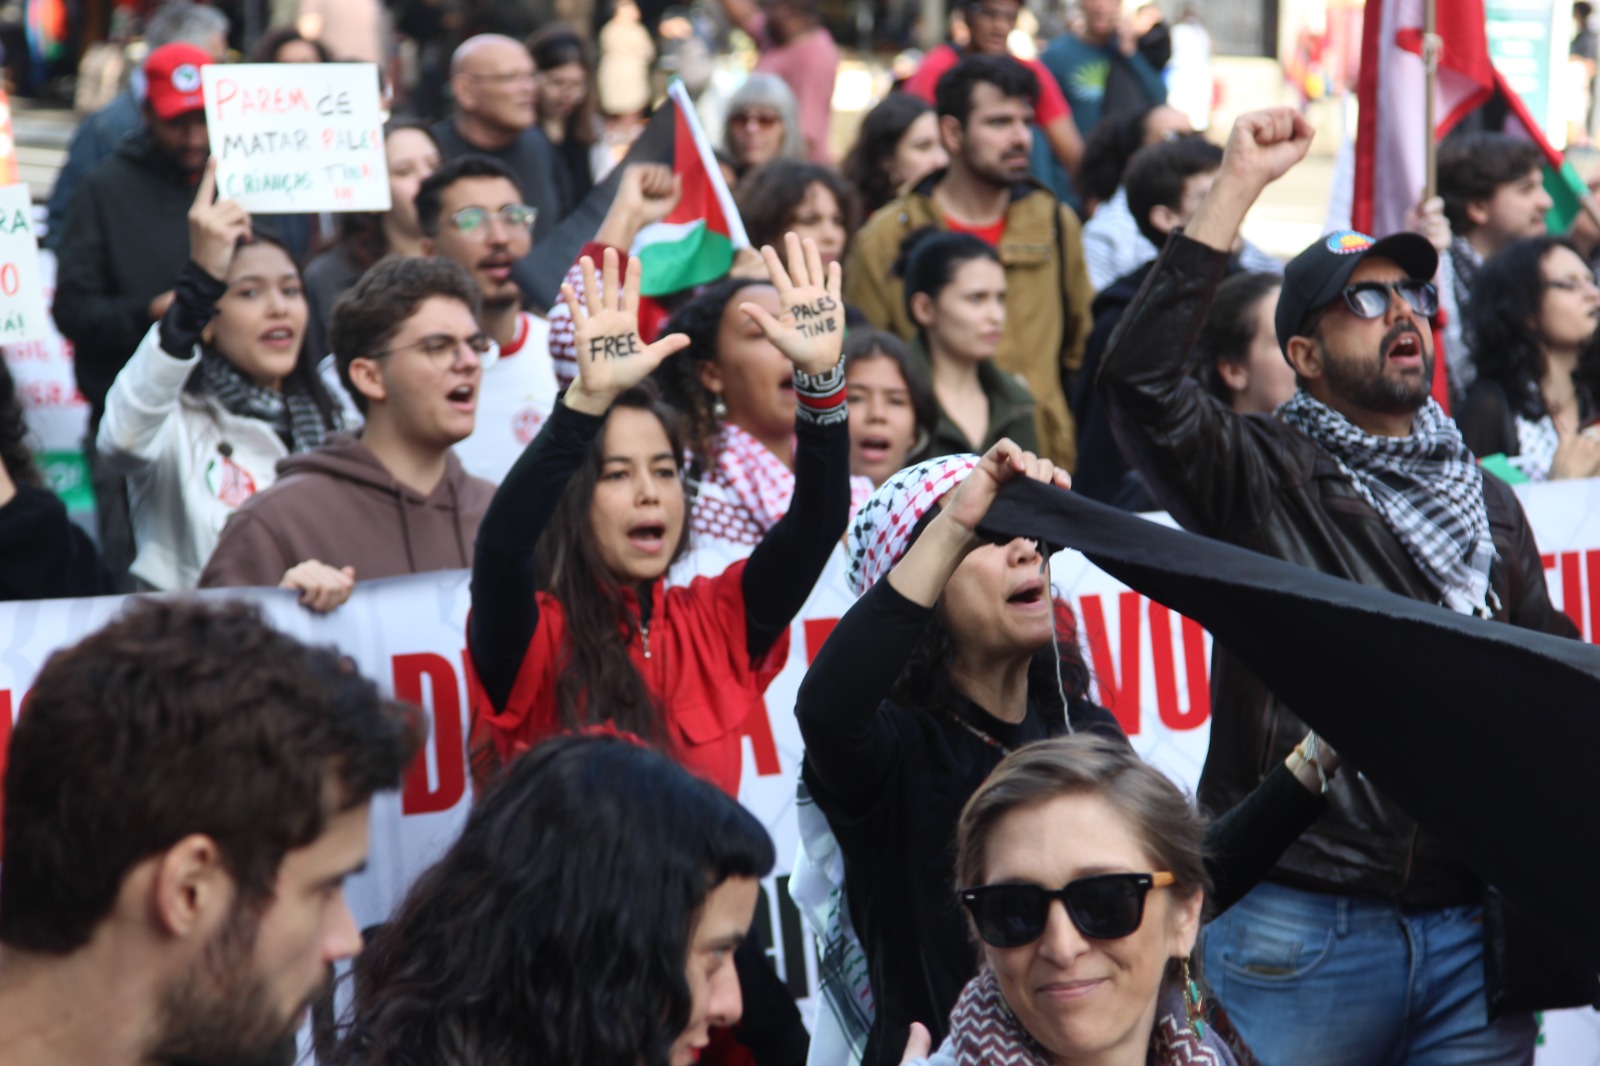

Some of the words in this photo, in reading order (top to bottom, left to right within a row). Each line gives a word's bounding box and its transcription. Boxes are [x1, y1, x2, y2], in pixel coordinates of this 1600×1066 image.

[214, 78, 309, 121] PAREM
[222, 128, 310, 159] MATAR
[790, 295, 837, 321] PALES
[795, 316, 837, 338] TINE
[589, 332, 640, 362] FREE
